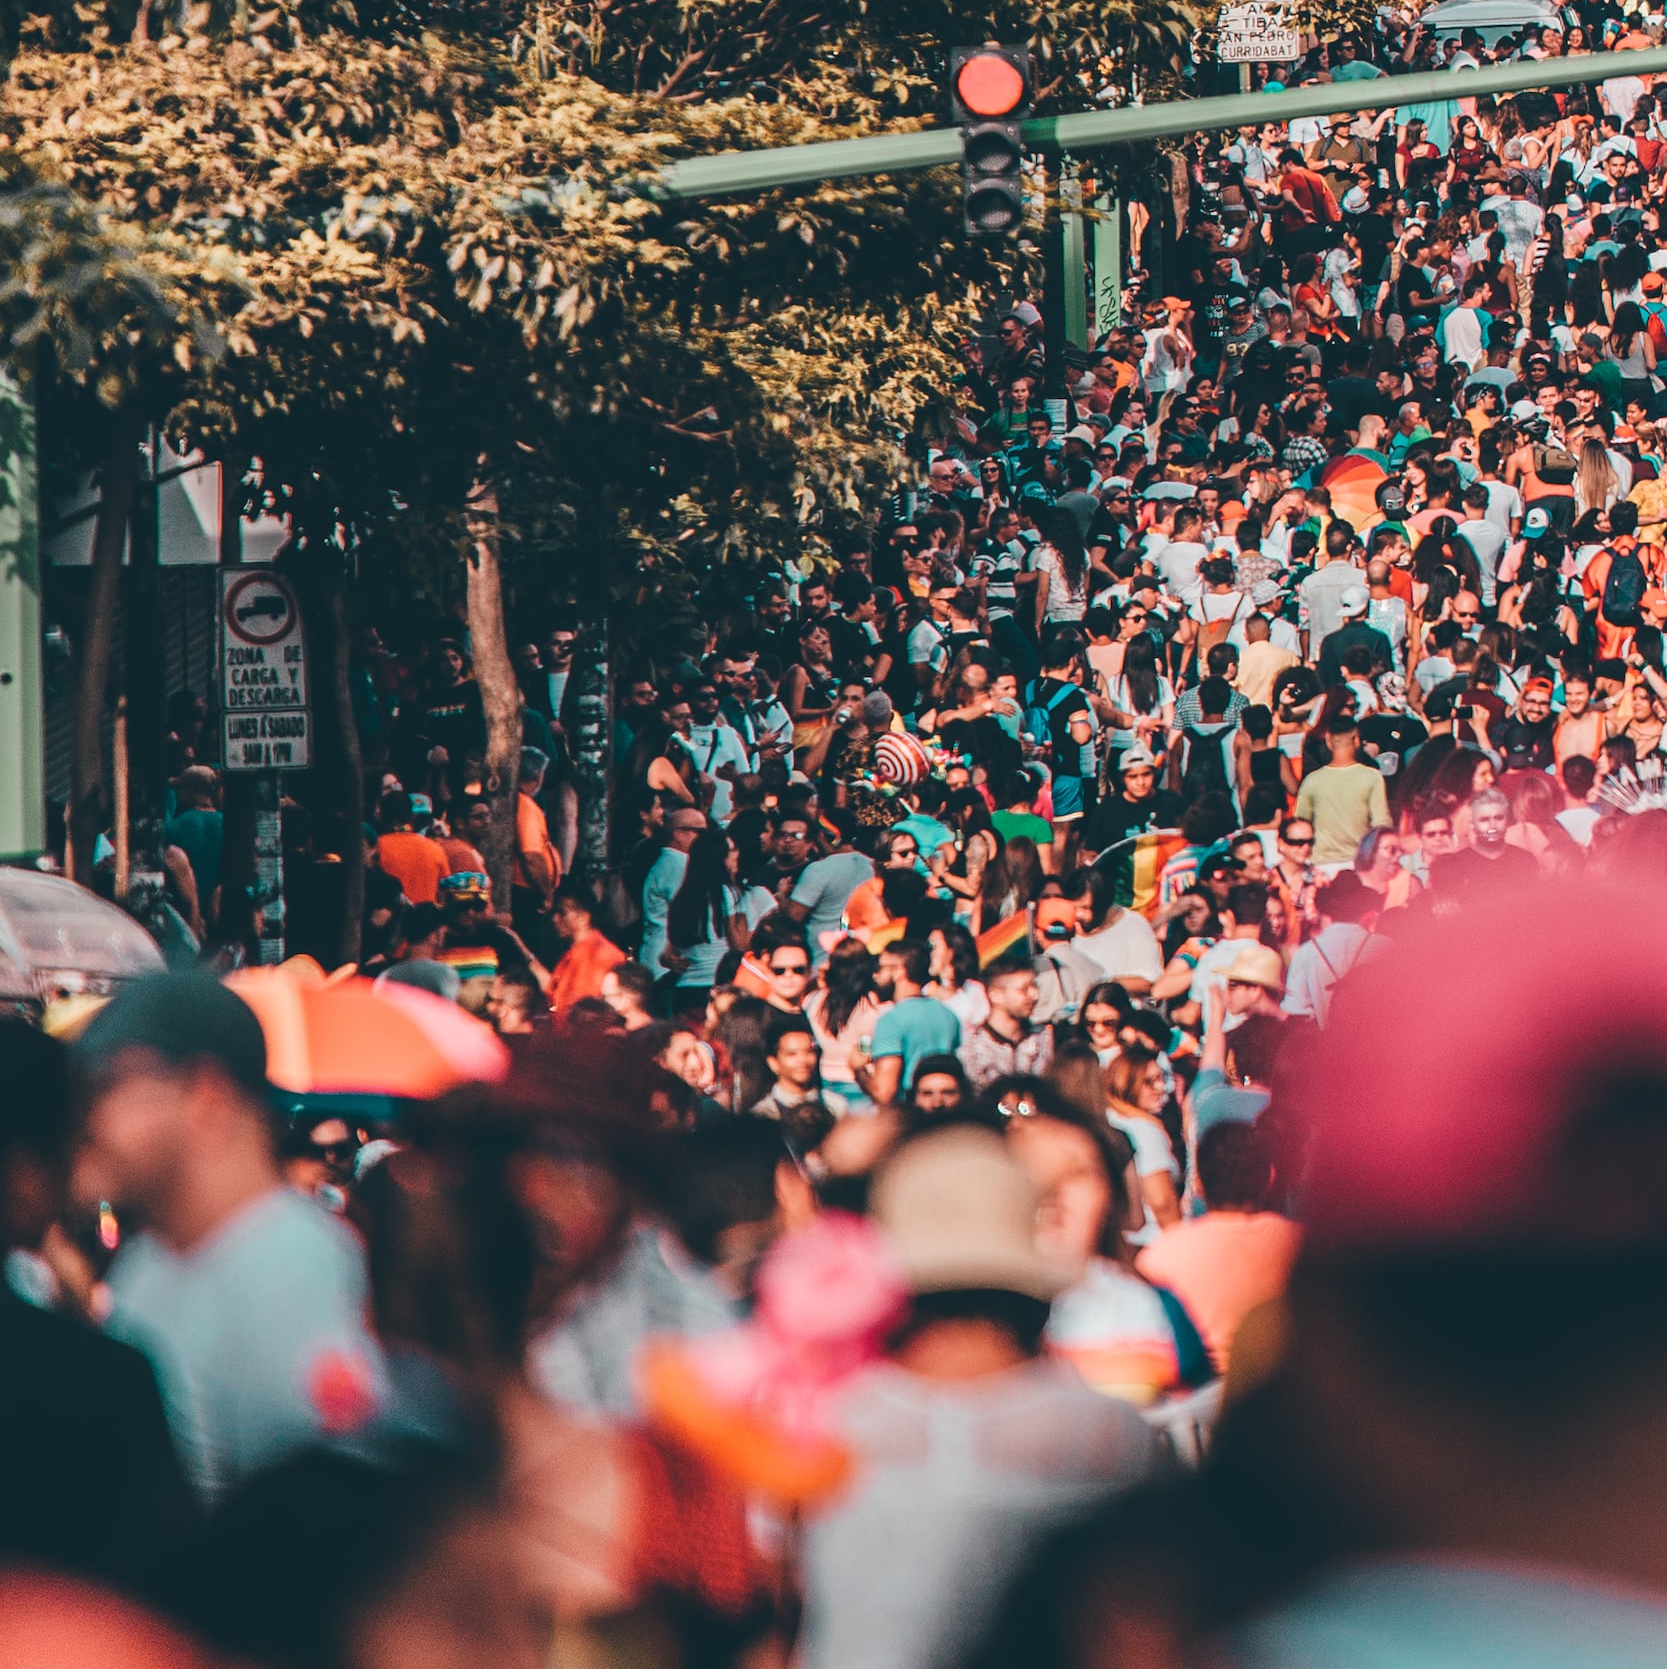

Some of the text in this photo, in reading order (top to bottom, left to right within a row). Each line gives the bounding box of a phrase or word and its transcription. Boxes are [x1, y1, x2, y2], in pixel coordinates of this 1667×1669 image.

[1221, 44, 1293, 58] CURRIDABAT
[228, 645, 302, 665] ZONA DE
[231, 667, 299, 685] CARGA Y
[229, 687, 301, 706] DESCARGA
